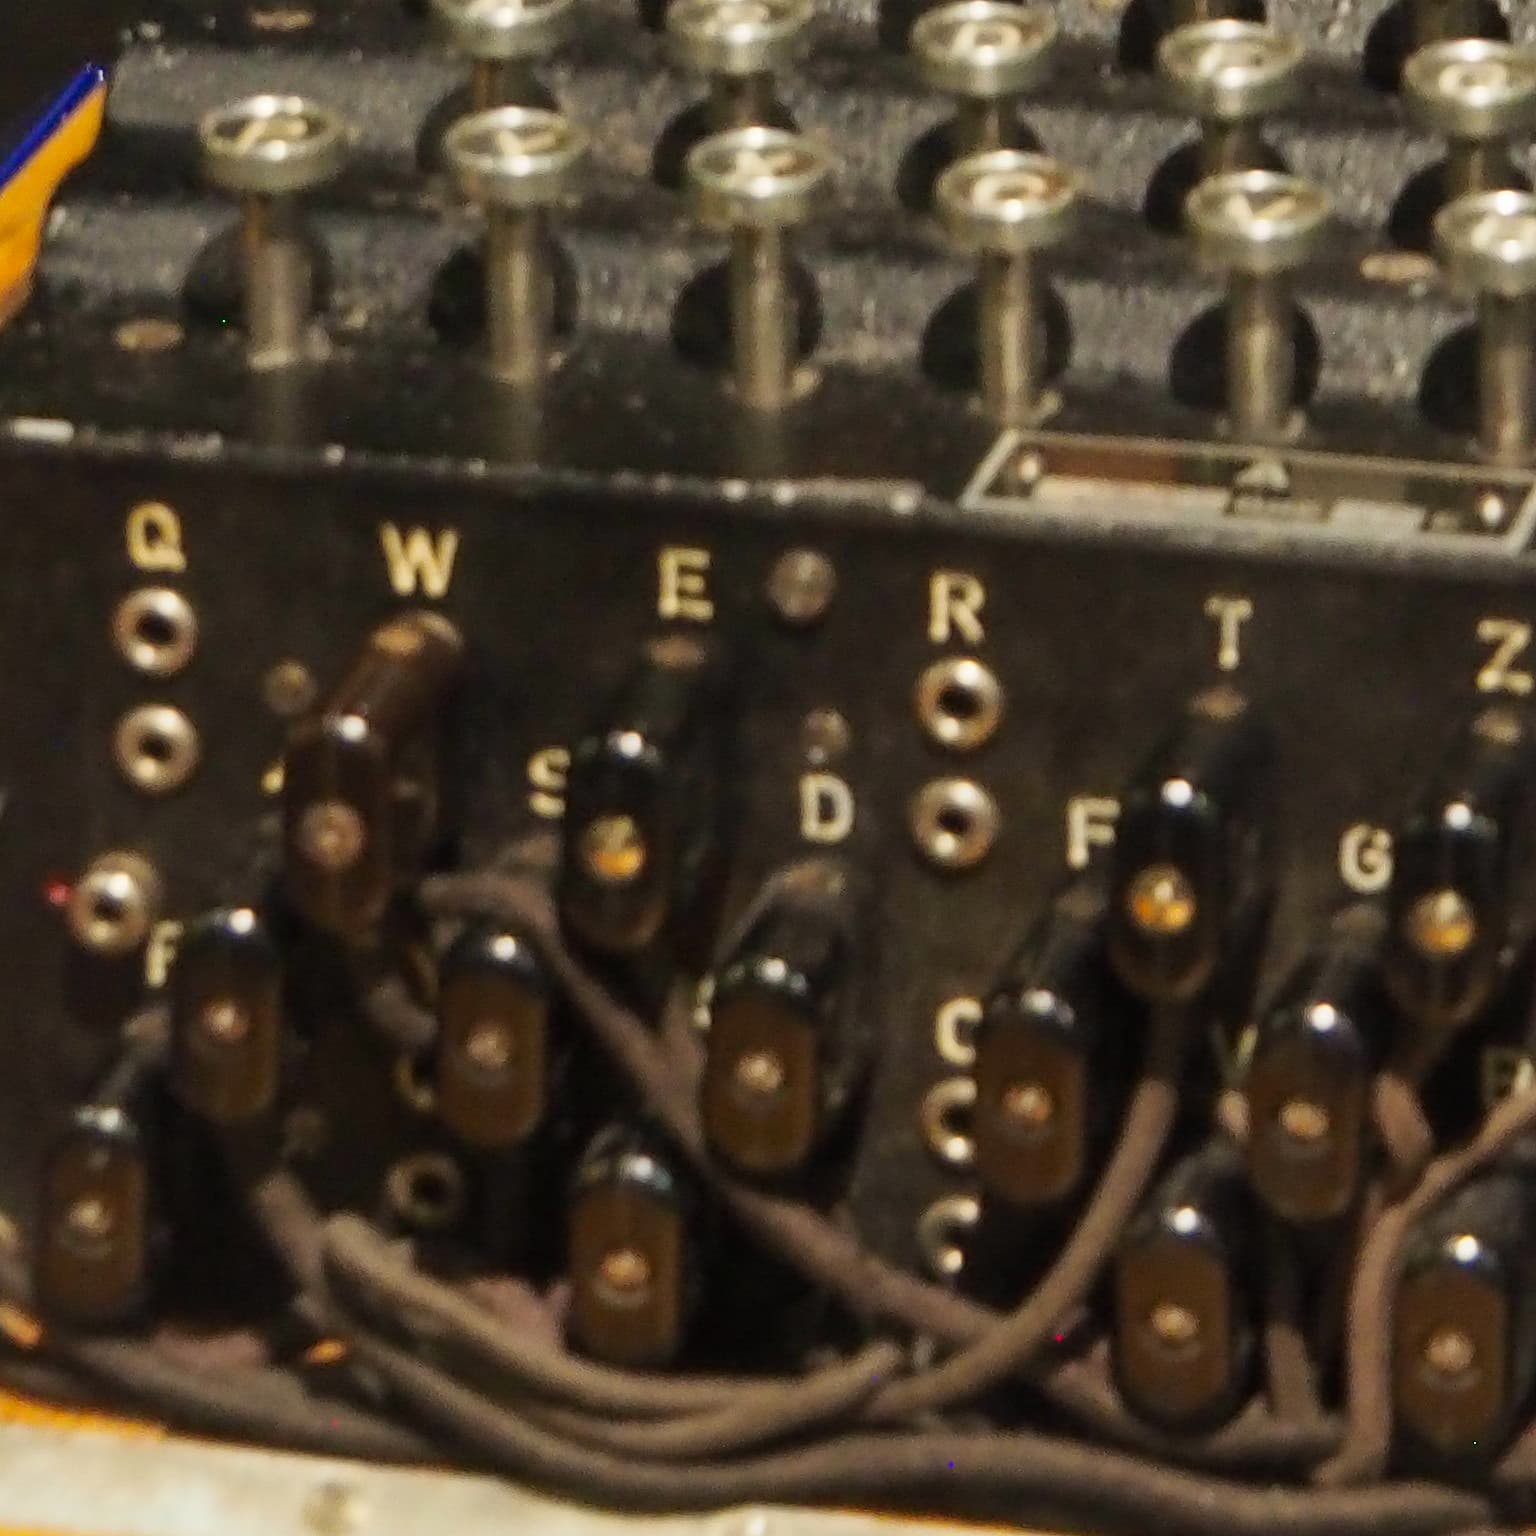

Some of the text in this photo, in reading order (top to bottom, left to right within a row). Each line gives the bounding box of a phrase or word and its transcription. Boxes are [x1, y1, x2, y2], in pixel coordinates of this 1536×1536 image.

[127, 501, 188, 572] Q
[382, 526, 458, 598] W
[656, 547, 715, 621] E
[927, 572, 986, 644] R
[1206, 595, 1254, 672] T
[1475, 618, 1535, 695] Z
[527, 747, 571, 818] S
[799, 772, 855, 843] D
[1066, 796, 1121, 869] F
[1339, 823, 1394, 894] G
